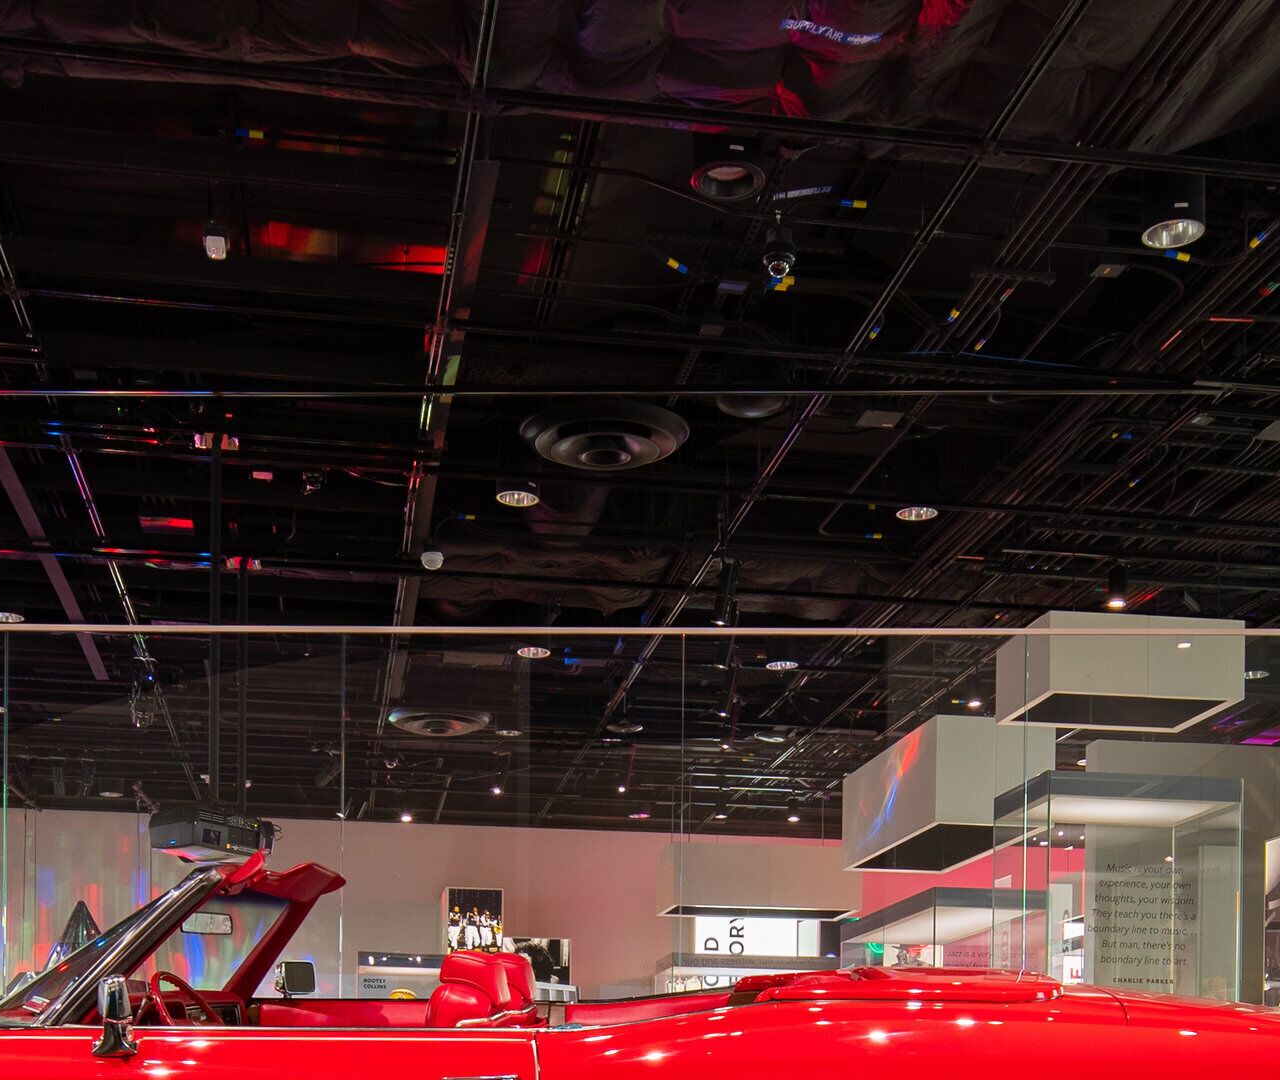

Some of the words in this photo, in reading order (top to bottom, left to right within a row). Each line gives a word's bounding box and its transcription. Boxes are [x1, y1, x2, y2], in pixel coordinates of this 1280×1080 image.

[786, 20, 826, 34] SUPPLY
[825, 29, 844, 41] AIR
[1107, 863, 1132, 873] Music
[1143, 866, 1163, 875] your
[1099, 880, 1148, 889] experience,
[1151, 882, 1170, 891] your
[1174, 882, 1191, 890] own
[1095, 894, 1137, 905] thoughts,
[1138, 897, 1158, 906] your
[1092, 908, 1112, 919] They
[1115, 909, 1138, 919] teach
[1141, 912, 1156, 921] you
[1088, 925, 1129, 935] boundary
[1132, 925, 1148, 934] line
[1150, 926, 1159, 935] to
[1102, 940, 1117, 949] But
[1120, 941, 1140, 950] man,
[1101, 955, 1144, 966] boundary
[1144, 956, 1160, 965] line
[1174, 958, 1188, 966] art.
